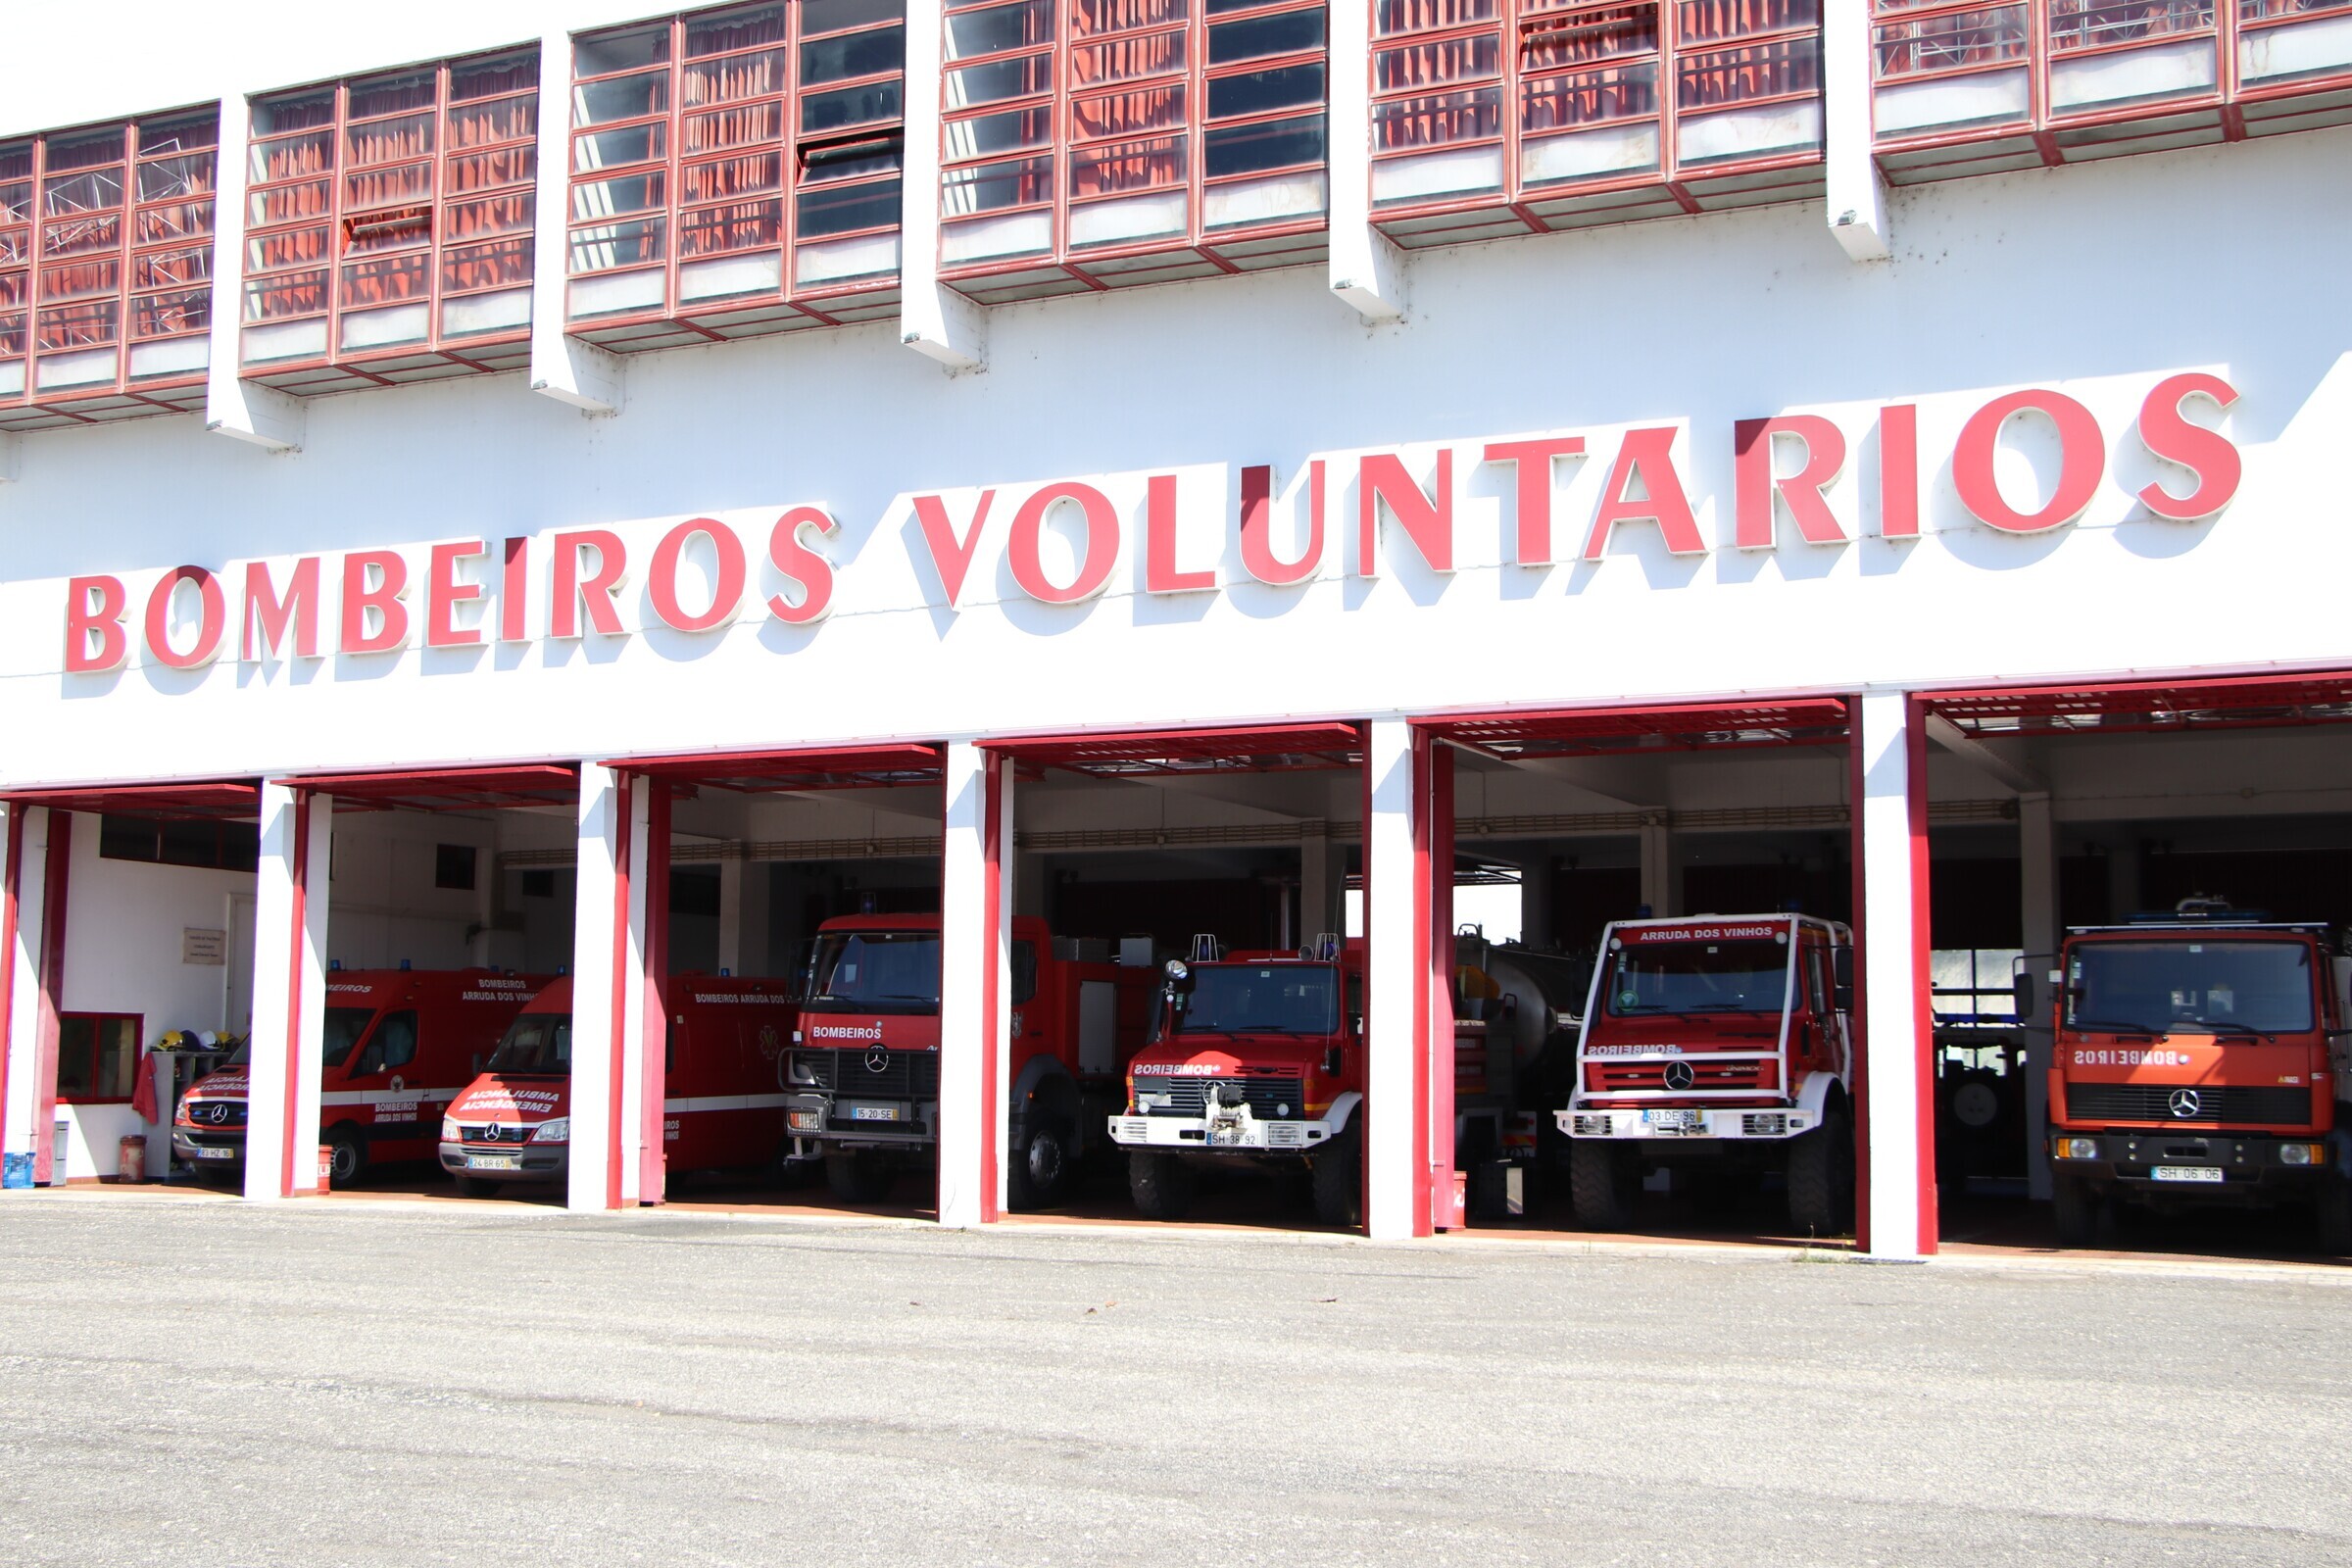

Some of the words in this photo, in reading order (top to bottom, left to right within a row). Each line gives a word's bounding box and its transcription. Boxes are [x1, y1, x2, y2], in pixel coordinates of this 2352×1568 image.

[66, 506, 841, 673] BOMBEIROS
[911, 372, 2243, 611] VOLUNTARIOS
[1641, 930, 1690, 941] ARRUDA
[1694, 929, 1720, 938] DOS
[1724, 927, 1772, 937] VINHOS
[478, 979, 526, 989] BOMBEIROS
[463, 991, 496, 1001] ARRUDA
[498, 992, 514, 1002] DOS
[695, 994, 739, 1004] BOMBEIROS
[740, 995, 769, 1004] ARRUDA
[770, 995, 784, 1004] DOS
[813, 1026, 882, 1039] BOMBEIROS
[375, 1102, 417, 1112] BOMBEIROS
